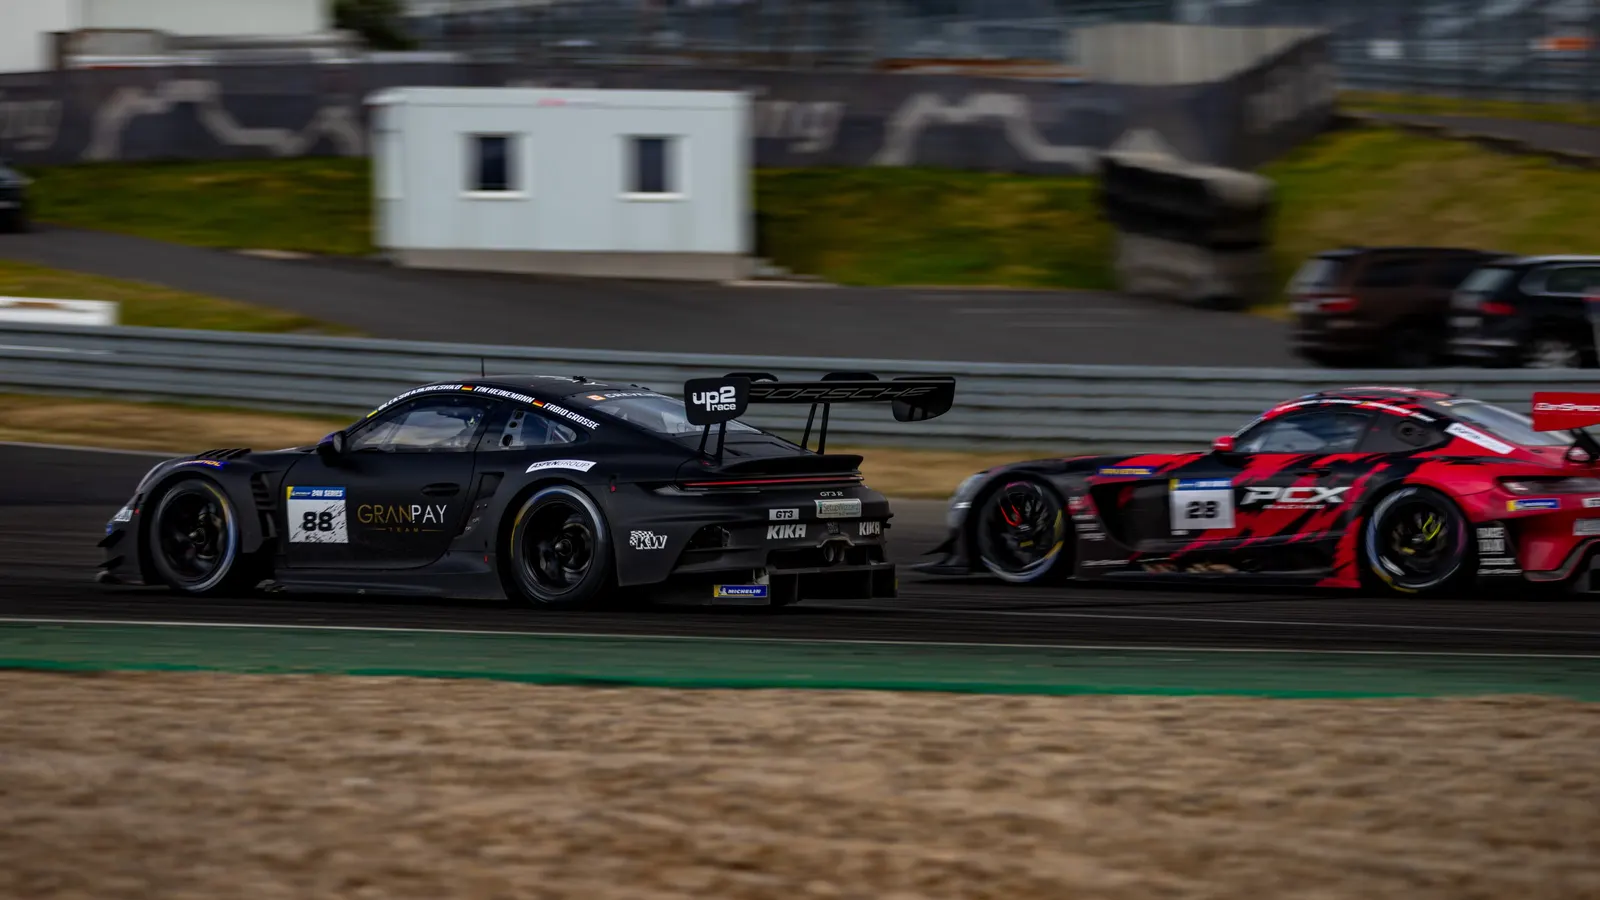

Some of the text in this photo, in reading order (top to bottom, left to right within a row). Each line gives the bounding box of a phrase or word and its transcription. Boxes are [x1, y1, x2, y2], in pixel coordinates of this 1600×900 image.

[473, 385, 535, 404] TIM HEINEMANN
[692, 386, 736, 412] up2
[543, 402, 600, 430] FABIO GROSSE
[711, 403, 737, 411] race
[1240, 486, 1353, 506] PCX
[357, 504, 447, 524] GRANPAY
[775, 510, 794, 519] GT3
[1185, 500, 1220, 519] 28
[302, 511, 333, 532] 88
[859, 521, 881, 536] KIKA
[766, 523, 807, 540] KIKA
[635, 533, 668, 550] KW
